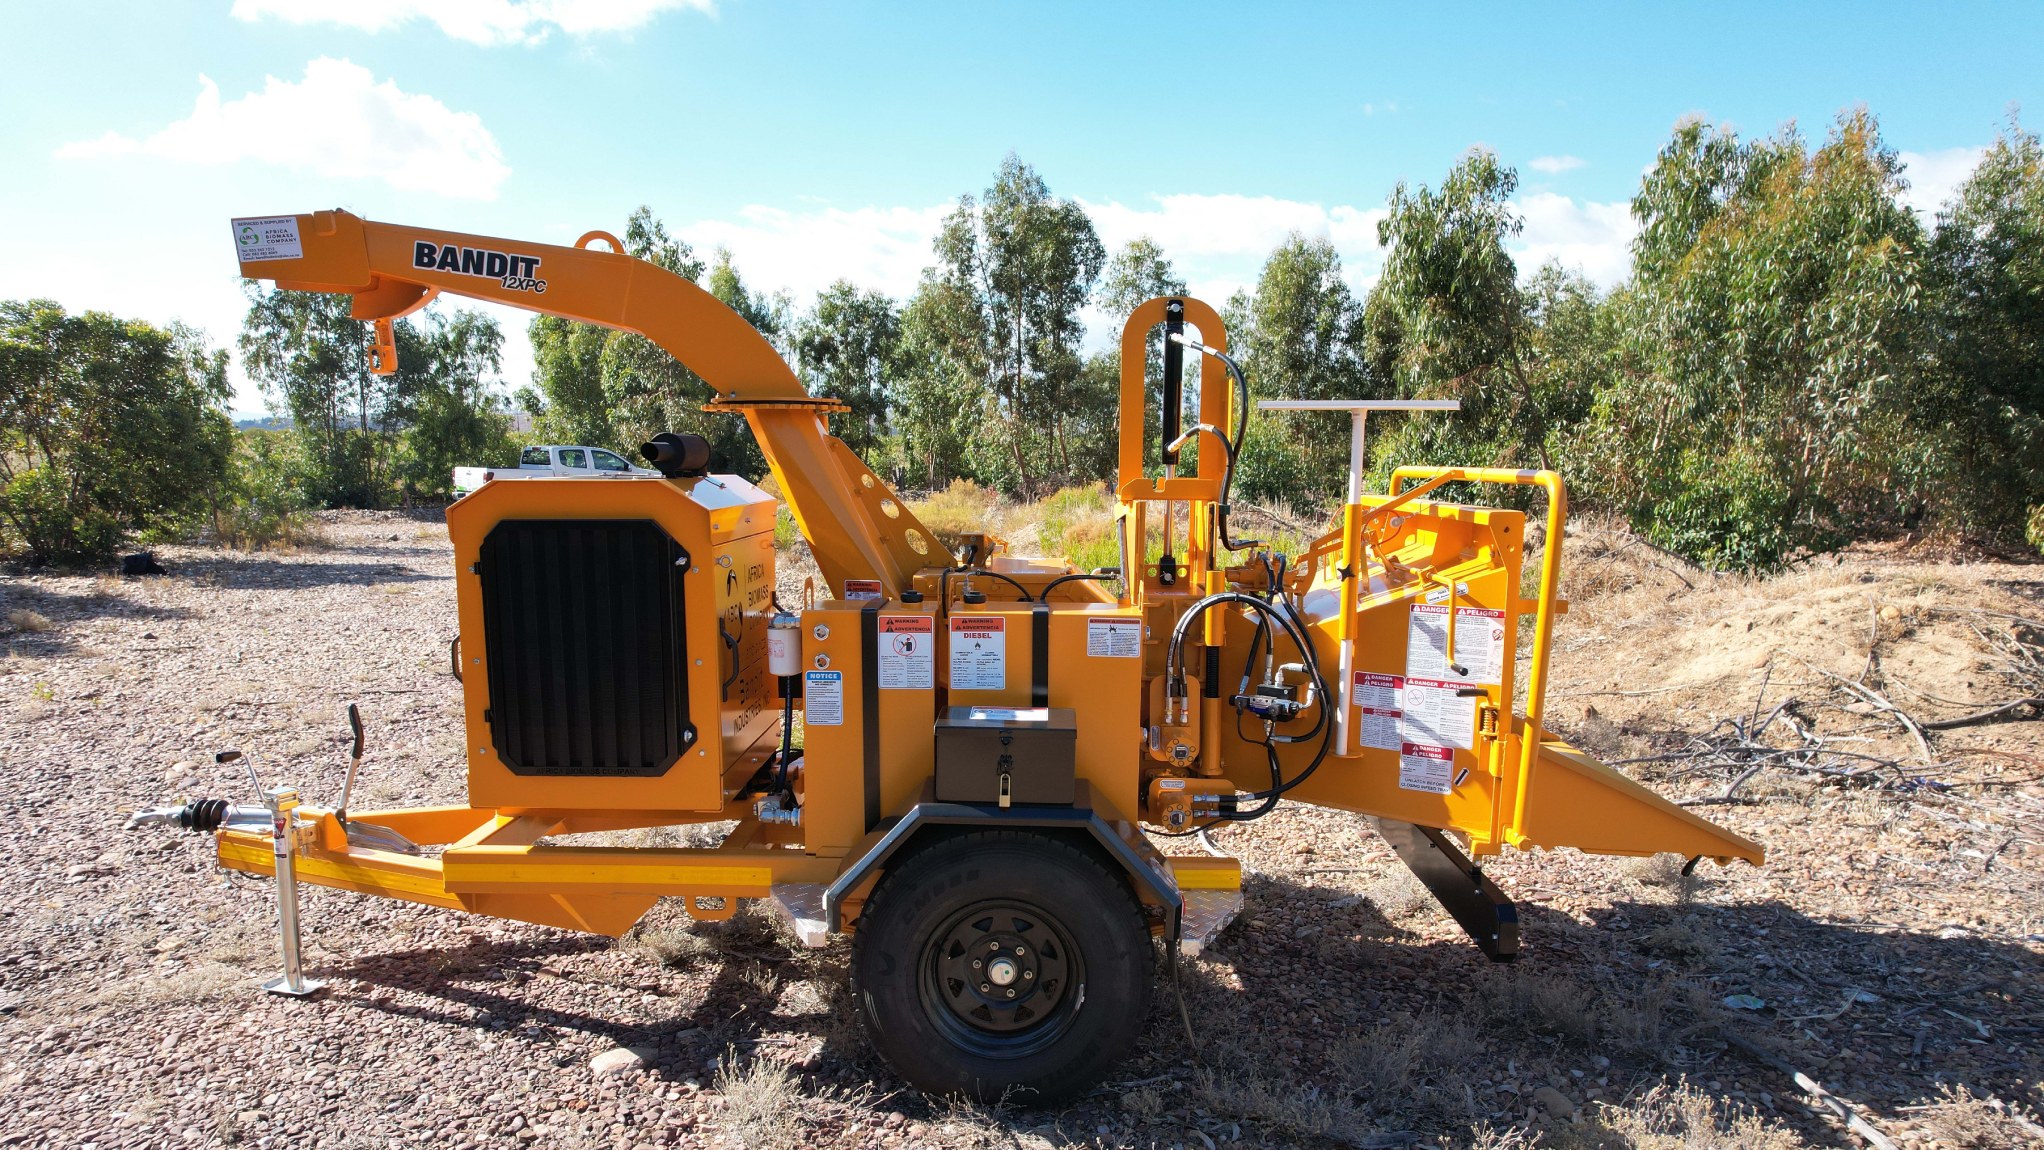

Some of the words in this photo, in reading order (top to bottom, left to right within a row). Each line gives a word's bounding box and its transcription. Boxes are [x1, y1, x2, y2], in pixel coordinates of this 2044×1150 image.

[414, 241, 541, 279] BANDIT
[501, 275, 547, 293] 12XPC
[1466, 609, 1499, 617] PELIGRO
